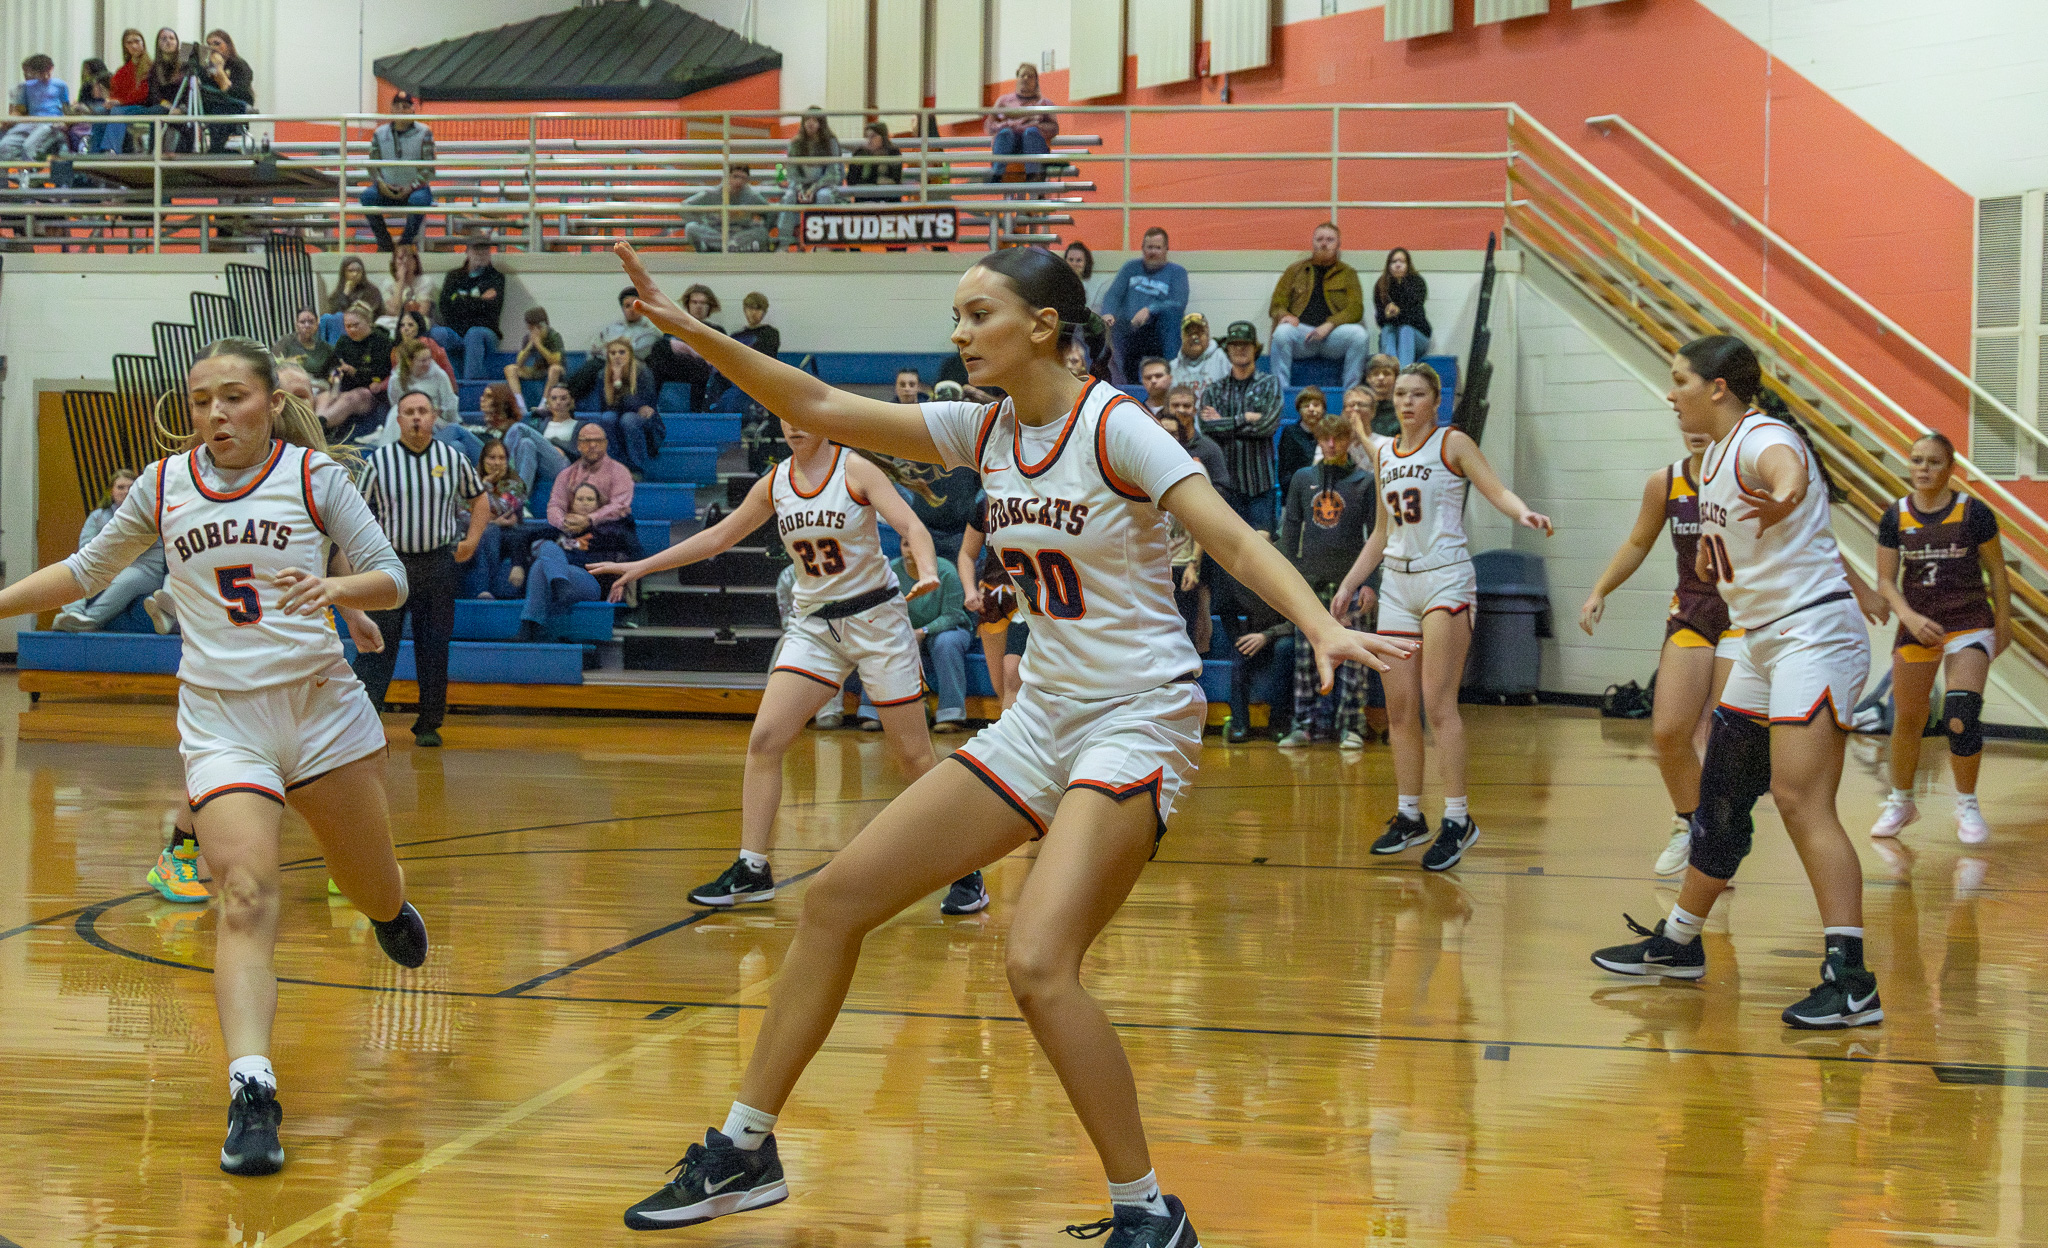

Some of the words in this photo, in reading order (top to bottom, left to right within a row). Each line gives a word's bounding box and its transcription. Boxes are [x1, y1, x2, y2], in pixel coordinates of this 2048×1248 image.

[806, 213, 955, 242] STUDENTS
[780, 510, 846, 536] BOBCATS
[990, 497, 1089, 536] BOBCATS
[174, 519, 293, 562] BOBCATS
[793, 537, 846, 577] 23
[214, 564, 263, 627] 5
